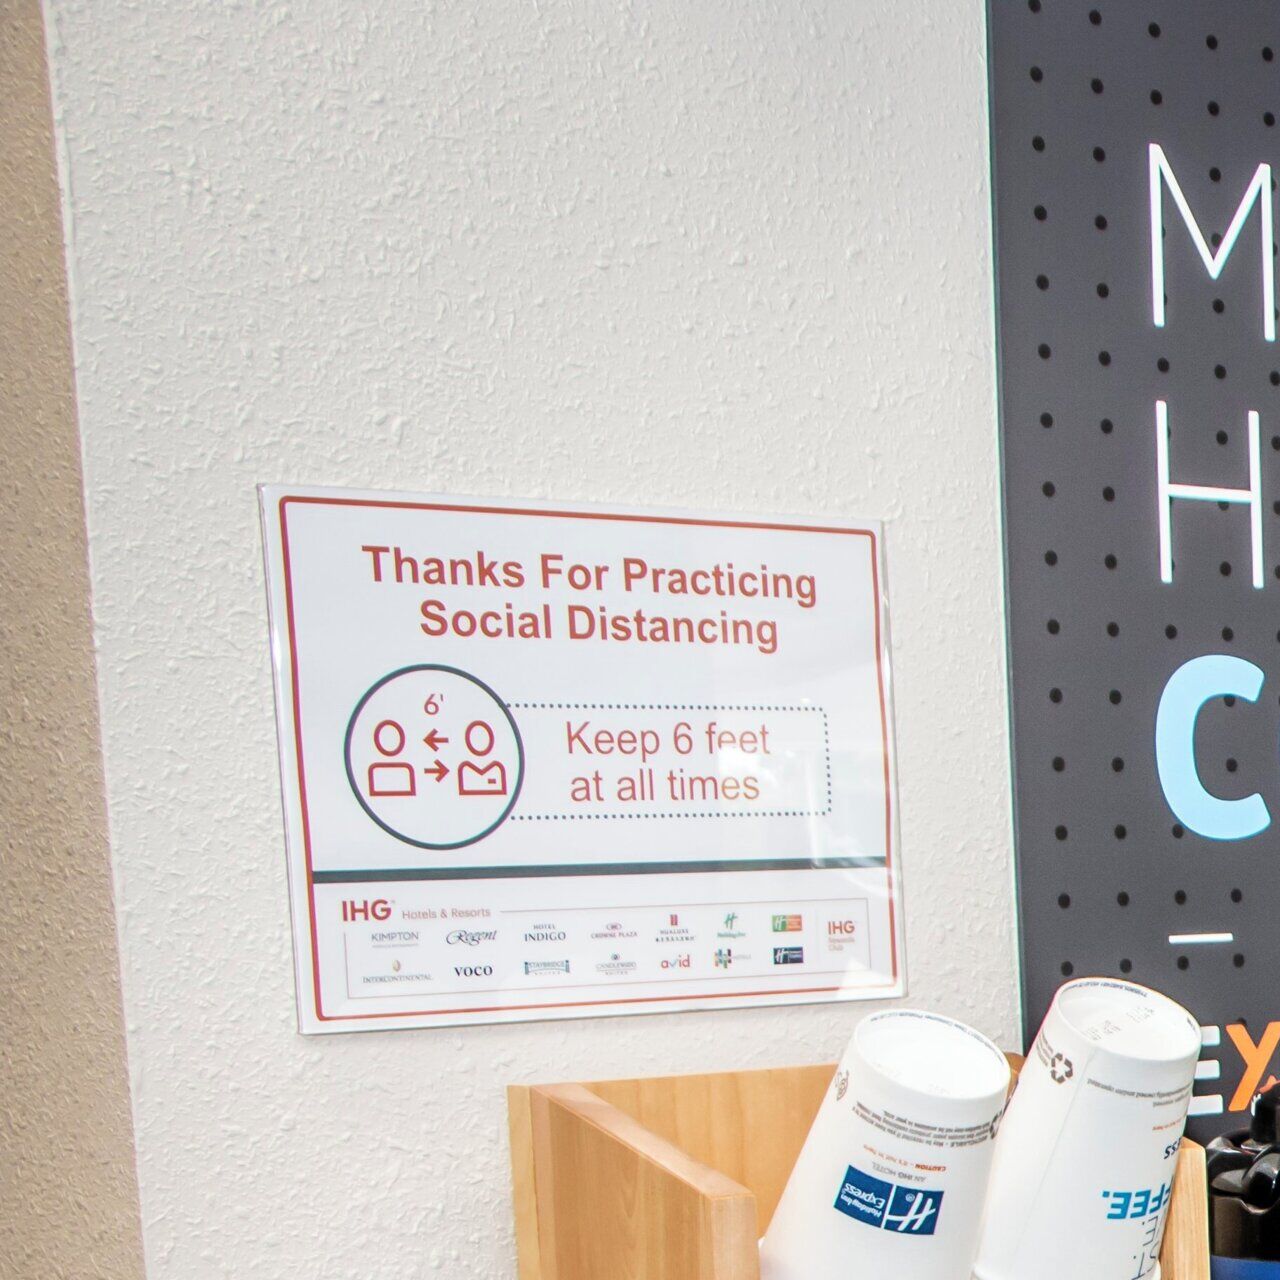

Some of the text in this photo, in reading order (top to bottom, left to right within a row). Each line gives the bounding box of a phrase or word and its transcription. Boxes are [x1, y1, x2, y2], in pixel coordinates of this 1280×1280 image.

[361, 544, 816, 608] Thanks For Practicing
[420, 599, 778, 654] Social Distancing
[424, 693, 444, 716] 6'
[565, 720, 771, 763] Keep 6 feet
[570, 768, 760, 802] at all times
[341, 899, 491, 921] IHG Hotels & Resorts
[371, 931, 419, 943] KIMPTON
[446, 929, 498, 946] Regent
[524, 931, 566, 942] INDIGO
[828, 920, 855, 935] IHG
[661, 954, 691, 969] avid
[914, 1163, 947, 1173] CAUTION
[843, 1182, 886, 1209] Express
